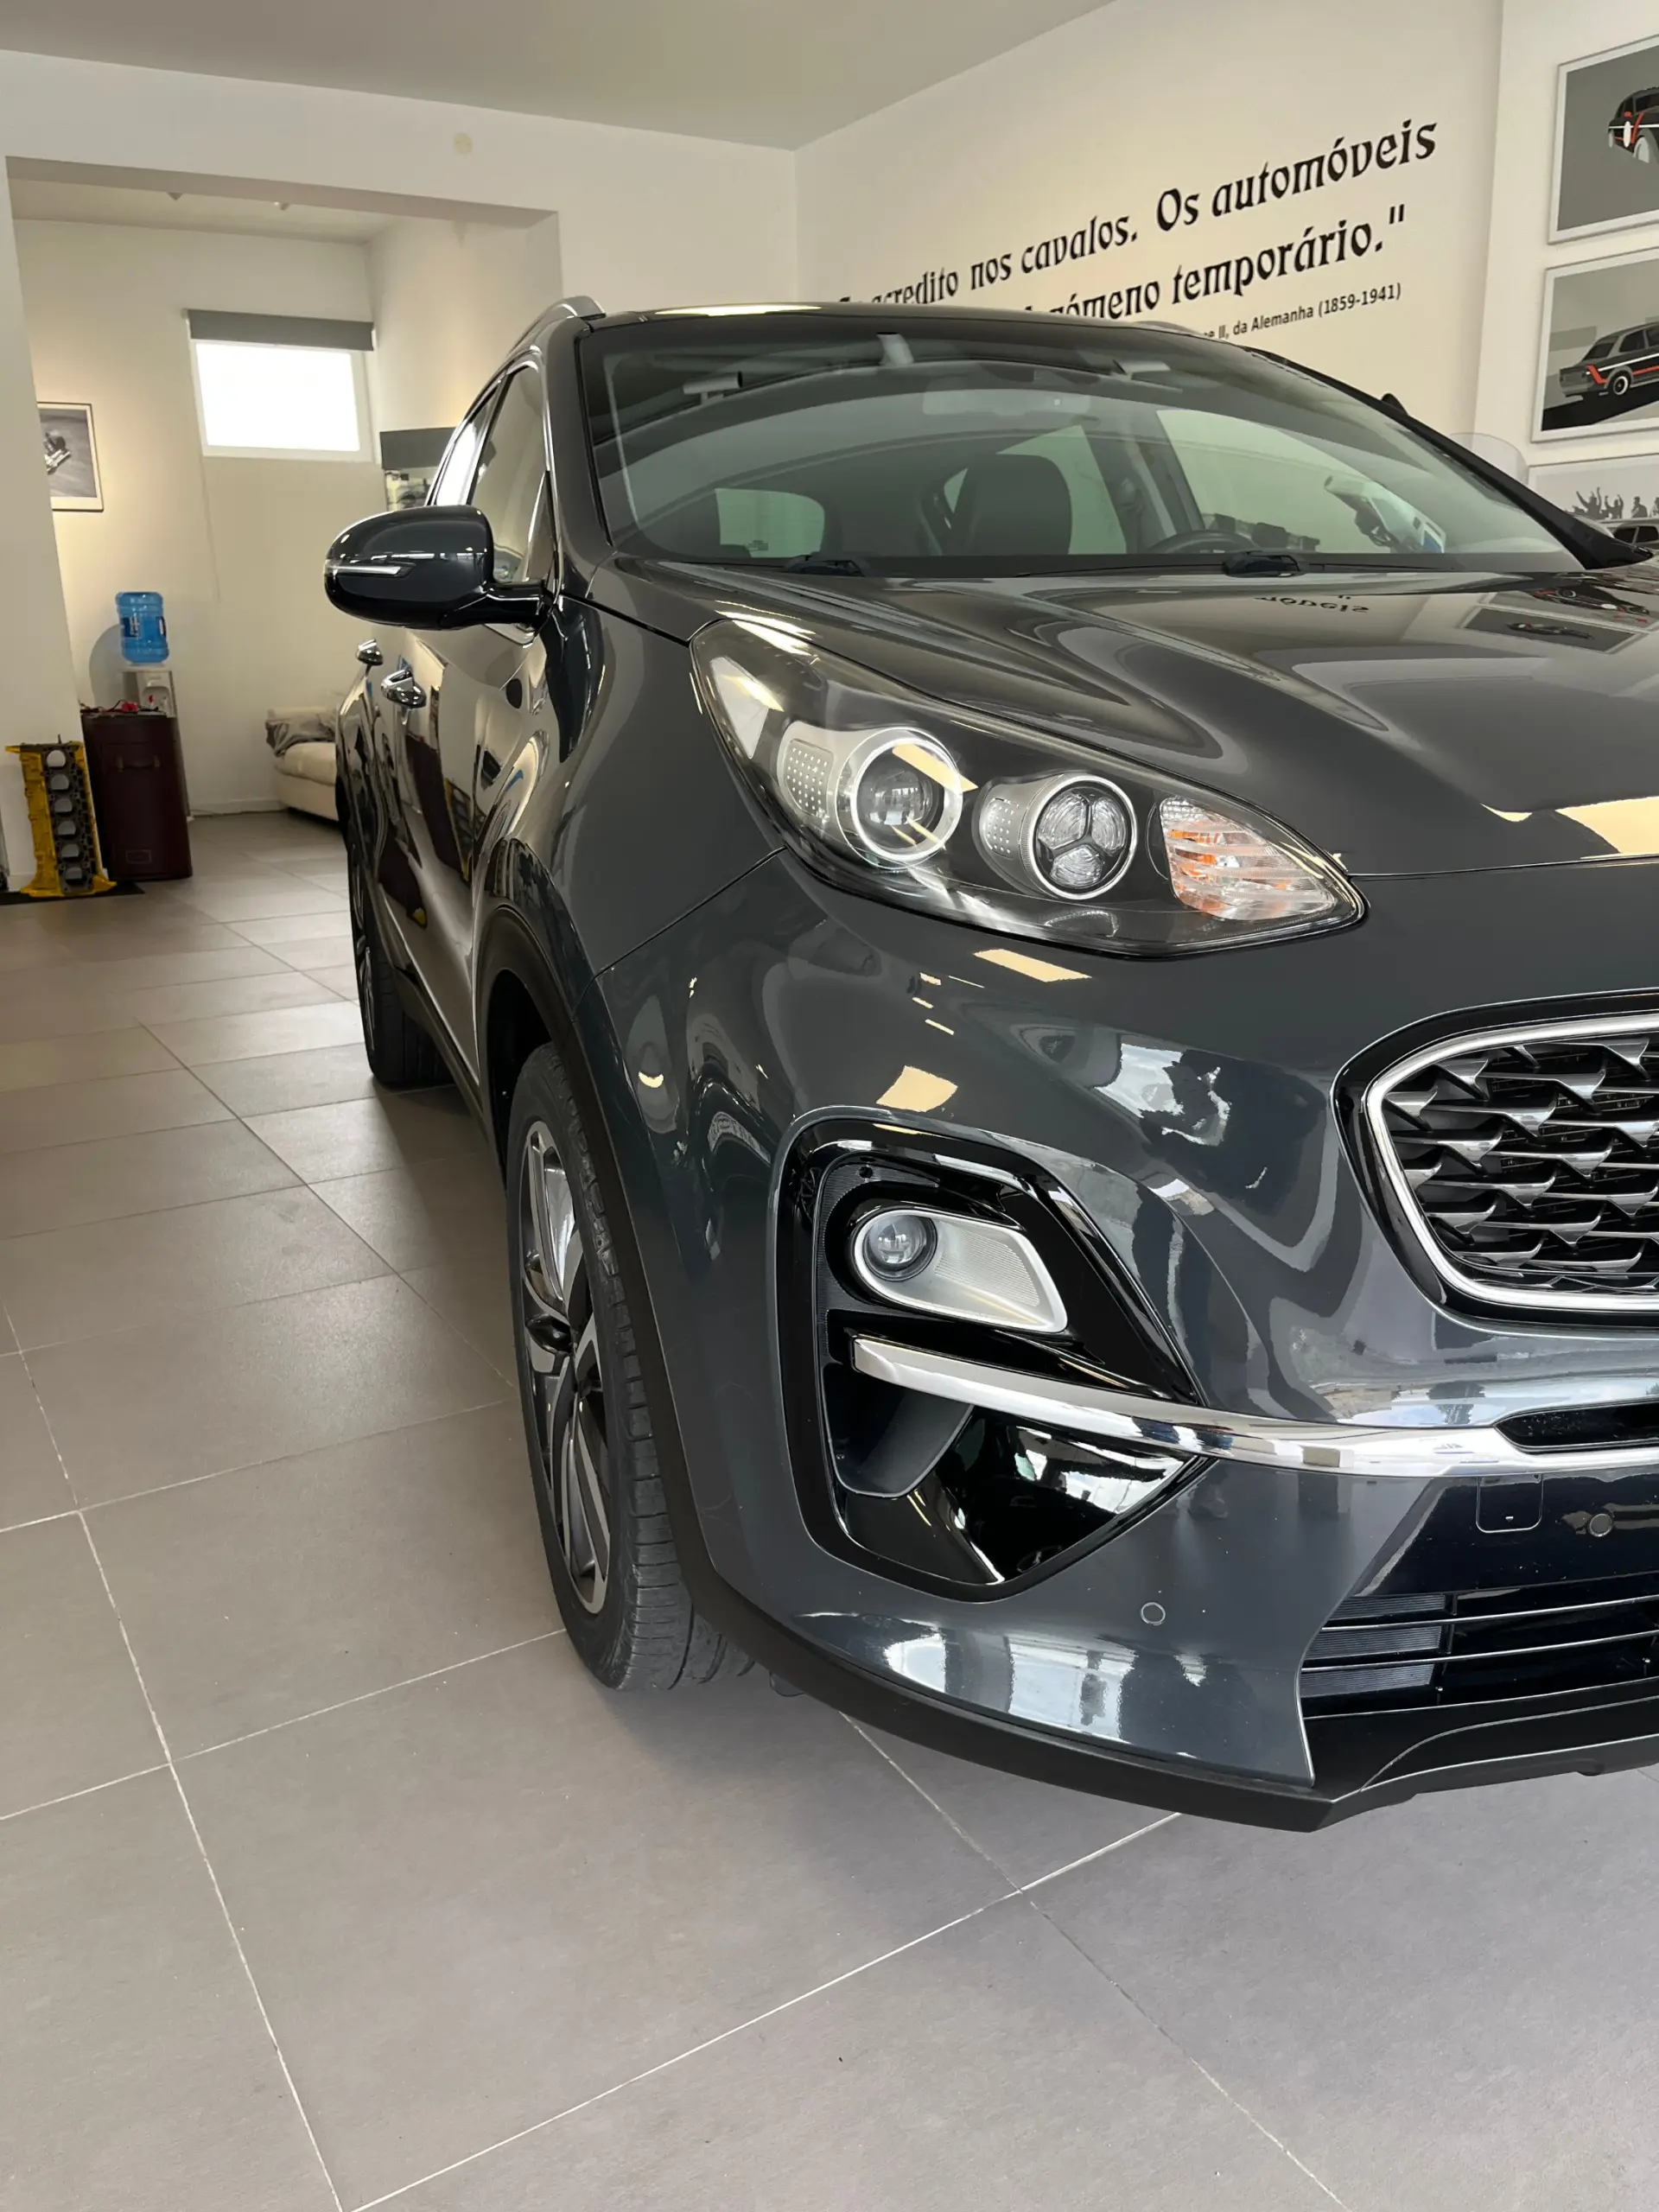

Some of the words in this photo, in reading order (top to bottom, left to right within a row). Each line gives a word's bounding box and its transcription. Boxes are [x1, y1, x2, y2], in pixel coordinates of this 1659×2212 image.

[969, 252, 1013, 290] nos
[1020, 214, 1138, 274] cavalos.
[1156, 188, 1200, 232] Os
[1211, 118, 1438, 217] automóveis
[1171, 203, 1406, 306] temporário."
[1232, 320, 1248, 335] da
[1250, 305, 1313, 332] Alemanha
[1318, 282, 1402, 318] (1859-1941)
